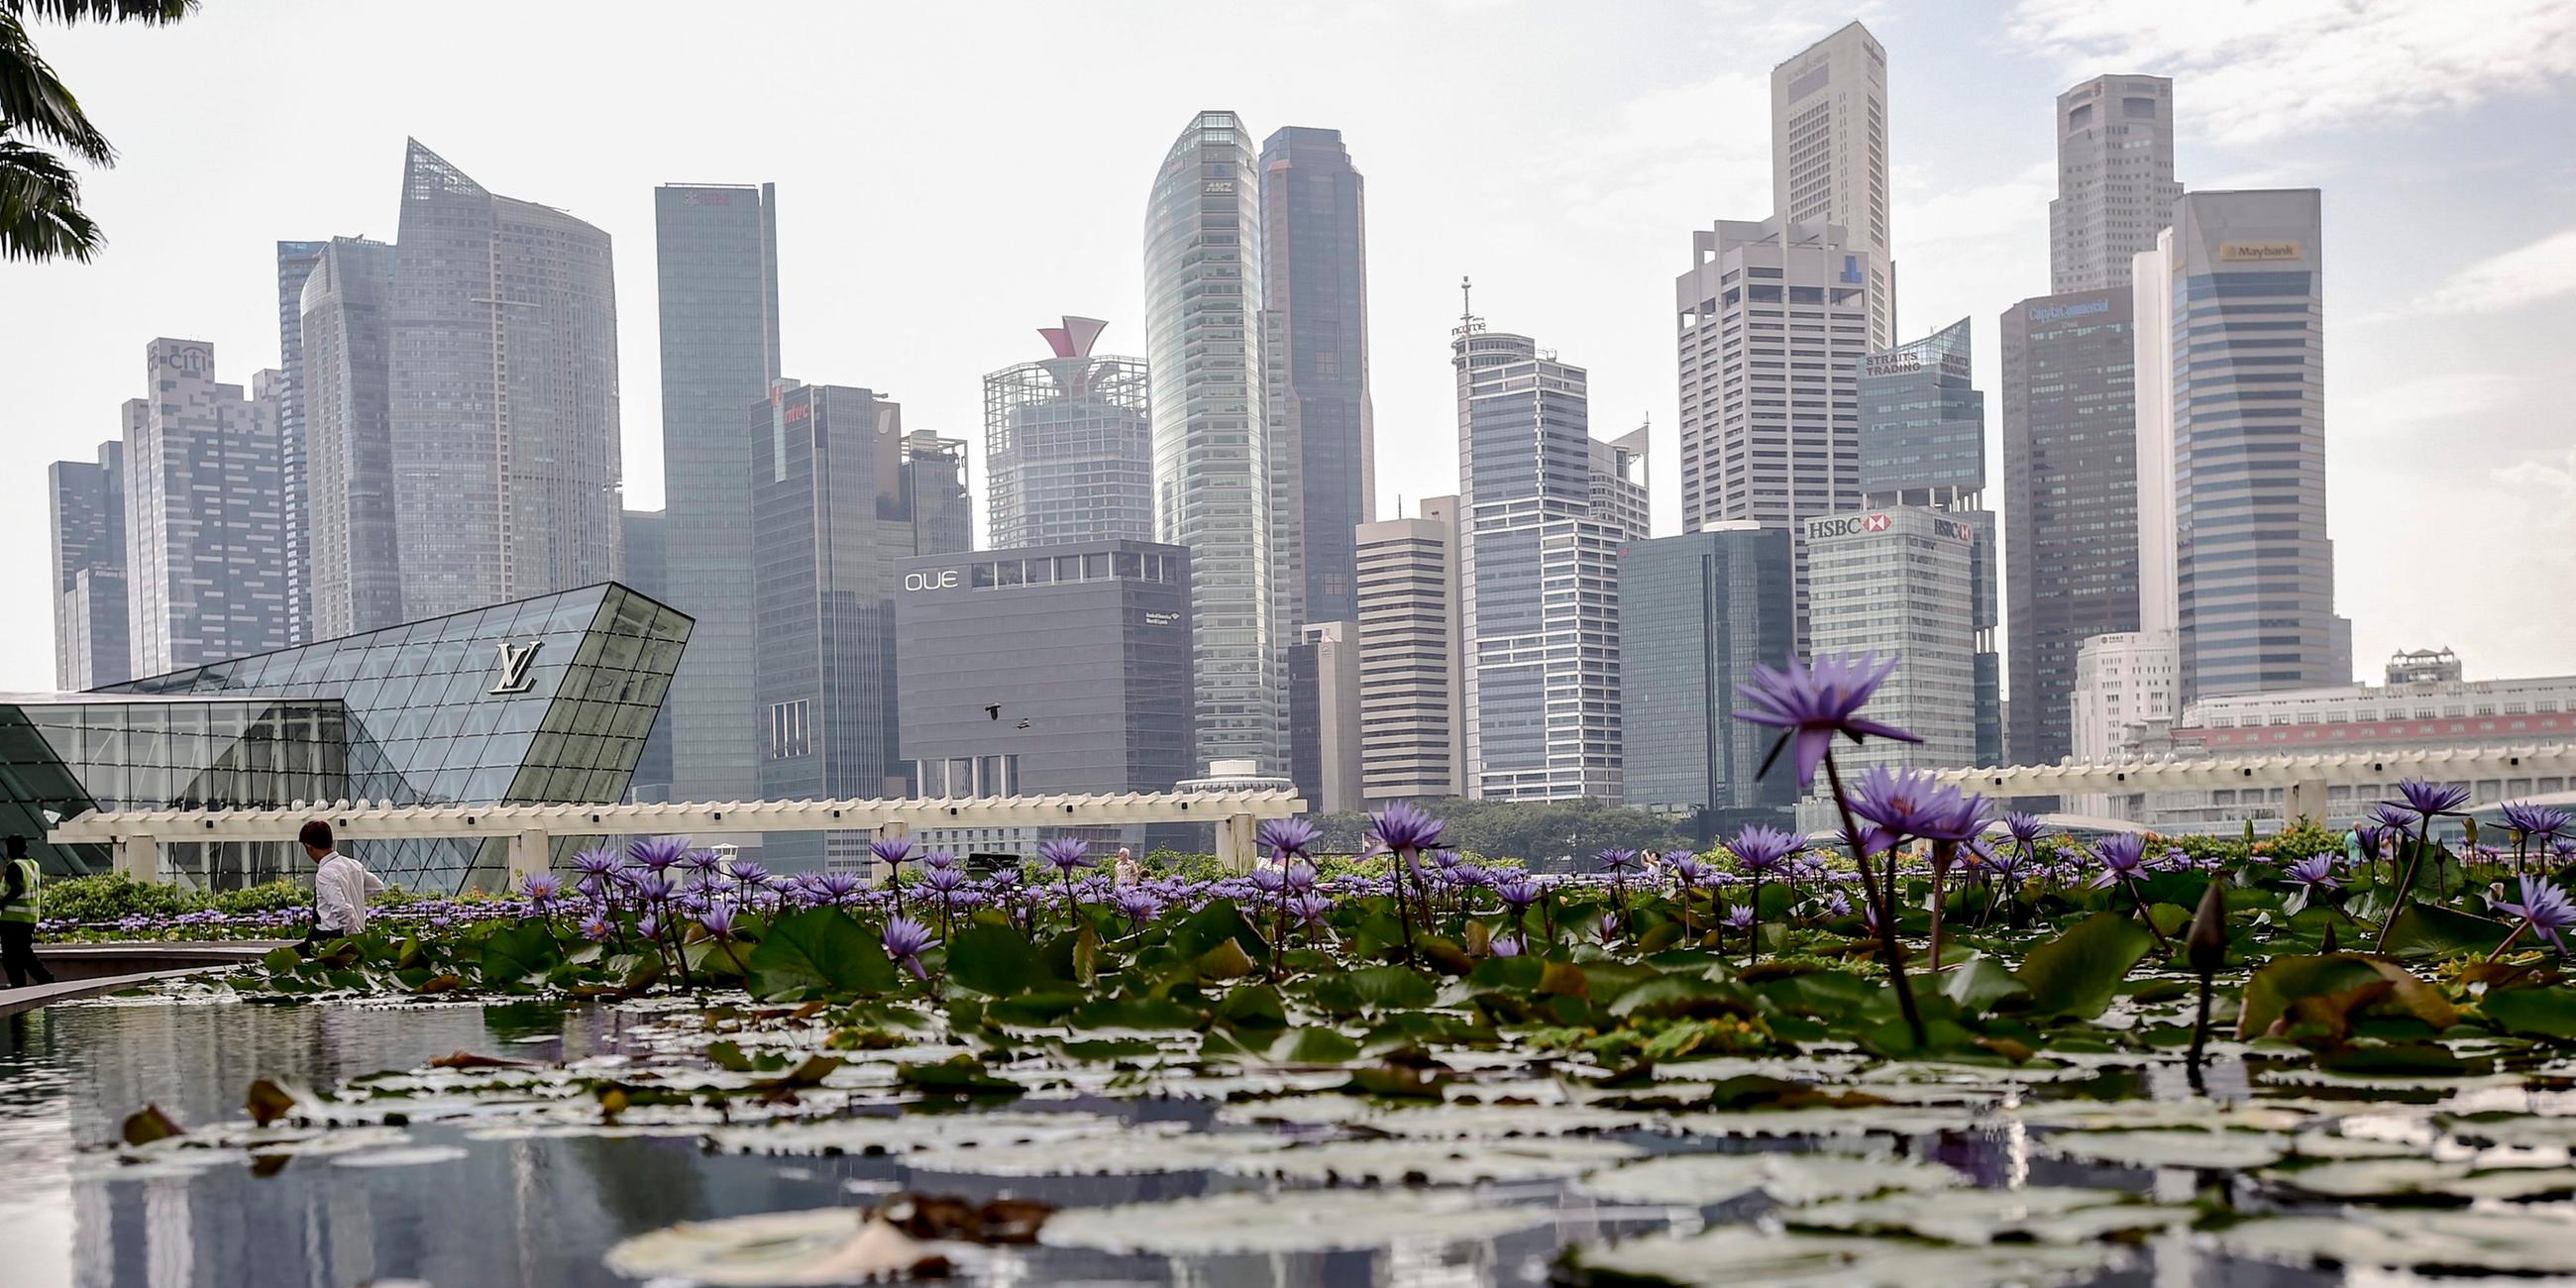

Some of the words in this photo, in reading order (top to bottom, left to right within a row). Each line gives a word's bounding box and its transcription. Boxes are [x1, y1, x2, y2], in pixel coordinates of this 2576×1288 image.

[2238, 245, 2294, 257] Maybank
[169, 347, 206, 372] citi
[1866, 352, 1918, 366] STRAITS
[1866, 363, 1921, 376] TRADING
[1809, 517, 1861, 539] HSBC
[1934, 518, 1958, 539] HSBC
[905, 570, 959, 591] OUE
